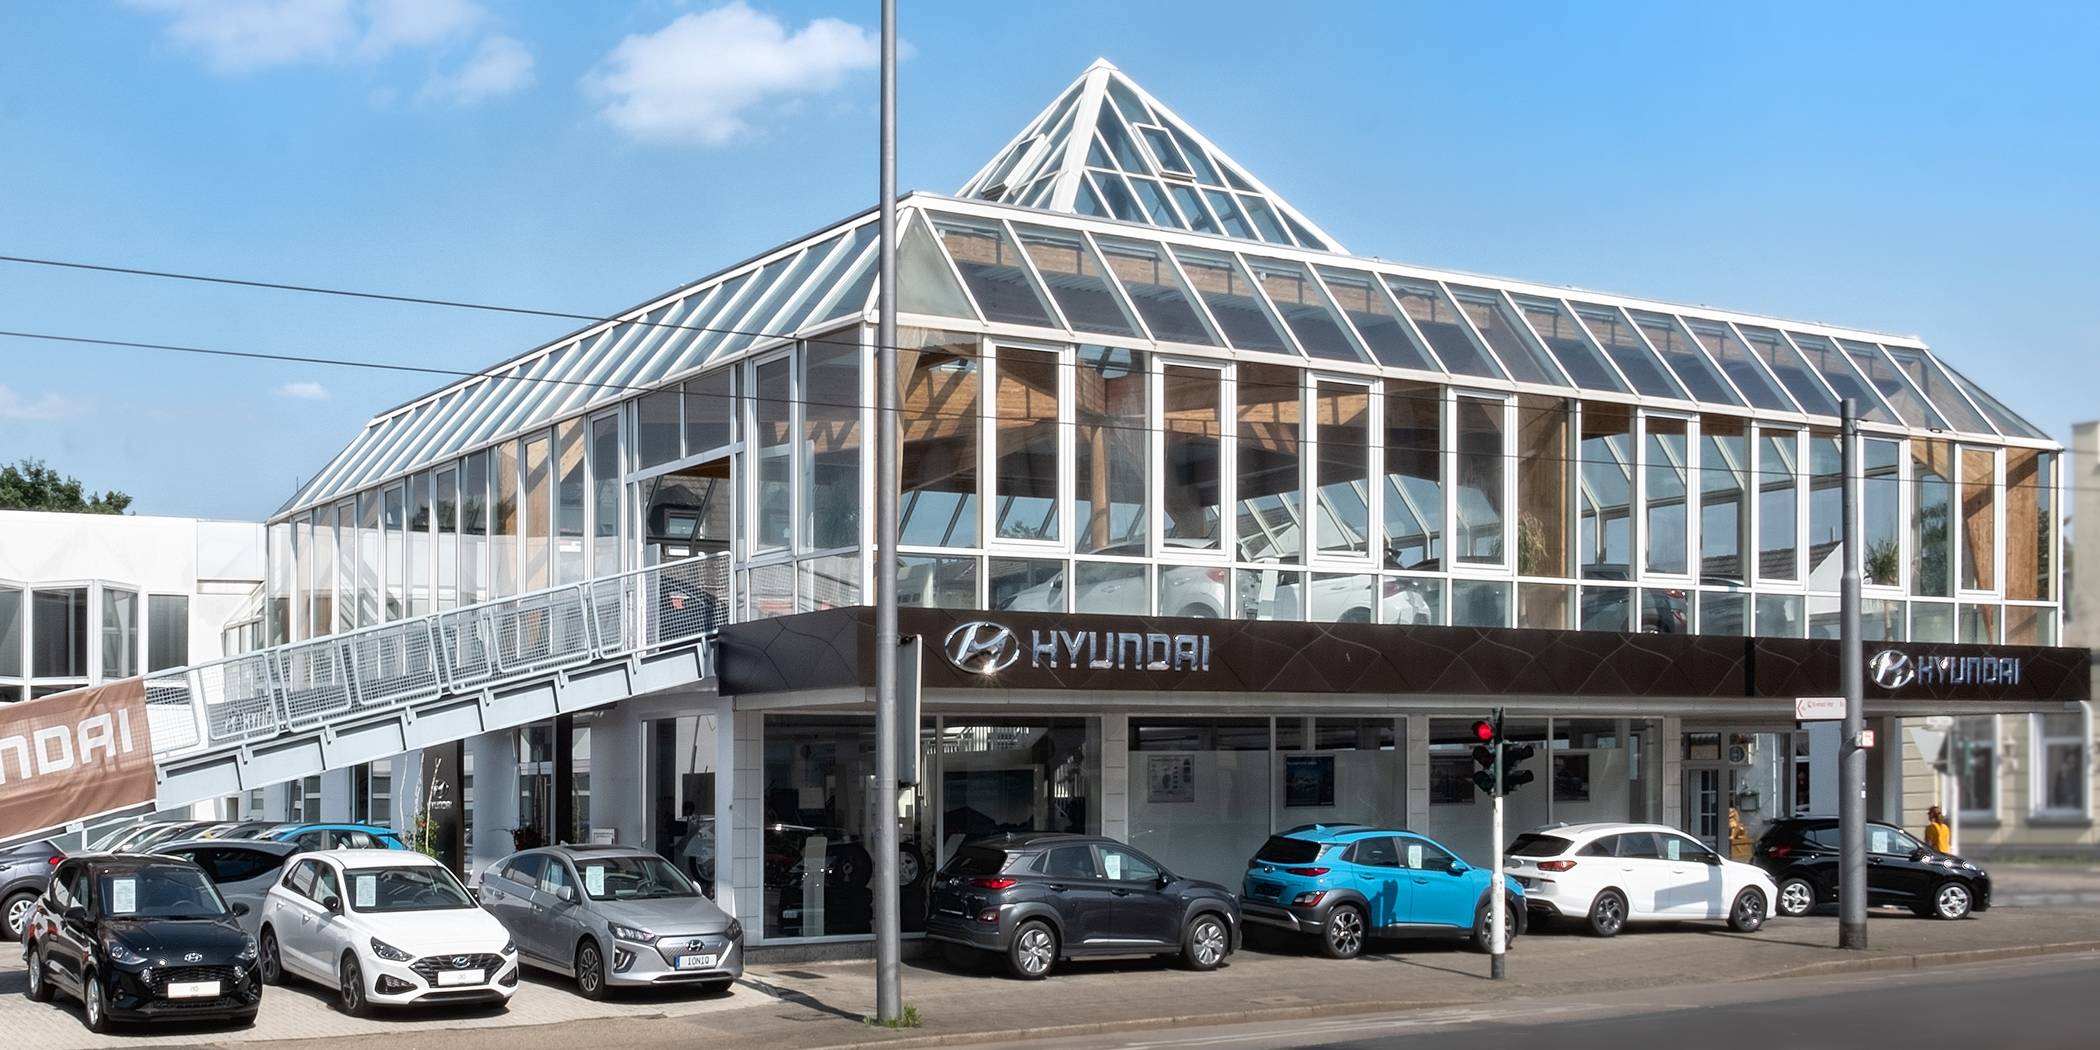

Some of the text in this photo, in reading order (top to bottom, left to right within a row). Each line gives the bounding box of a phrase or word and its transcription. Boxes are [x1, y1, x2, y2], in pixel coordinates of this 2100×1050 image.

[1031, 629, 1211, 672] HYUNDAI
[1918, 655, 2020, 685] HYUNDAI
[688, 955, 710, 966] IONIQ
